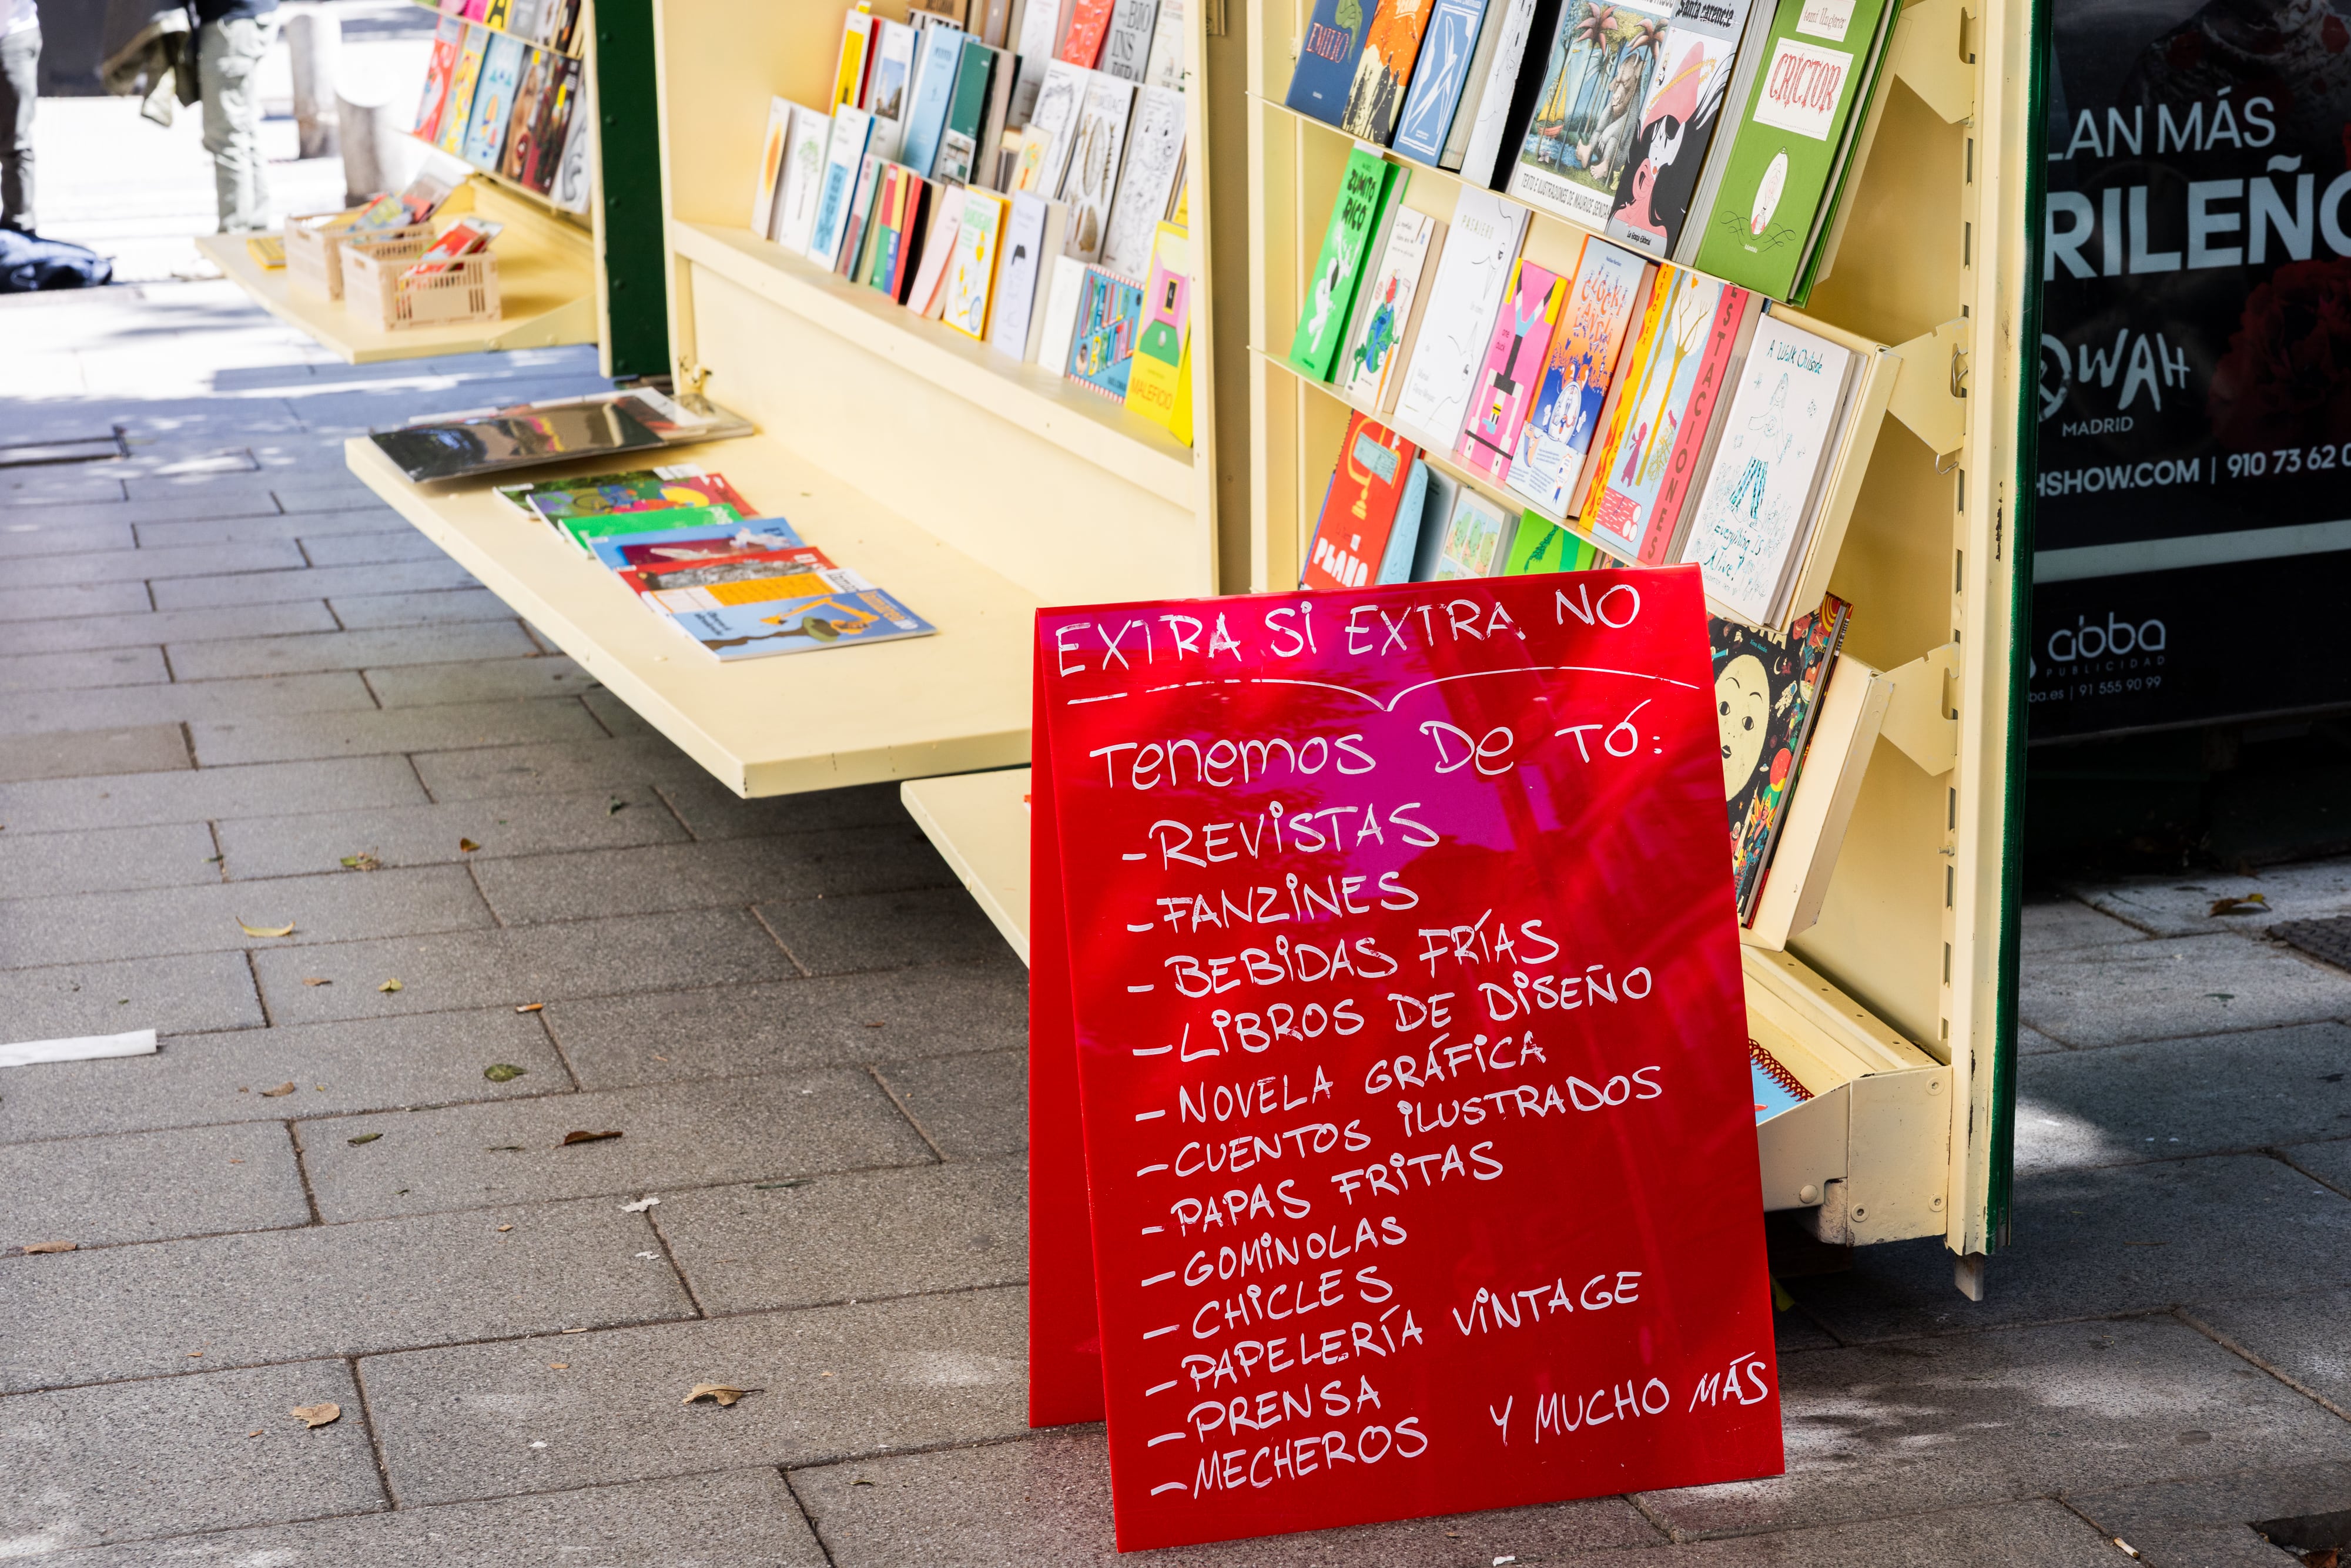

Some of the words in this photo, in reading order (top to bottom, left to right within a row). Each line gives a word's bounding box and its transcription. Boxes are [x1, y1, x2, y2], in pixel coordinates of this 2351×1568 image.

[1305, 22, 1349, 63] EMILIO
[2158, 86, 2276, 154] MÁS
[1502, 329, 1510, 338] one
[1766, 339, 1775, 357] A
[1777, 341, 1797, 364] Walk
[1797, 349, 1823, 374] Outside
[2079, 328, 2191, 411] WAH
[2062, 416, 2134, 437] MADRID
[2227, 453, 2266, 479] 910
[2273, 449, 2301, 473] 73
[2307, 445, 2335, 469] 62
[1056, 612, 1242, 677] EXTRA
[1345, 599, 1526, 656] EXTRA
[1556, 584, 1640, 629] NO
[2046, 655, 2165, 678] PUBLICIDAD
[2079, 684, 2093, 697] 91
[2099, 681, 2122, 694] 555
[2126, 678, 2142, 691] 90
[2146, 676, 2162, 689] 99
[1090, 734, 1377, 790] Tenemos
[1419, 721, 1514, 775] De
[1419, 909, 1559, 979] FRÍAS
[1388, 992, 1455, 1032] DE
[1478, 965, 1652, 1021] DISEÑO
[1365, 1031, 1546, 1094] GRÁFICA
[1397, 1066, 1663, 1138] ILUSTRADOS
[1331, 1141, 1504, 1205] FRITAS
[1453, 1272, 1643, 1336] VINTAGE
[1490, 1396, 1513, 1445] Y
[1536, 1378, 1670, 1444] MUCHO
[1689, 1352, 1768, 1413] MÁS
